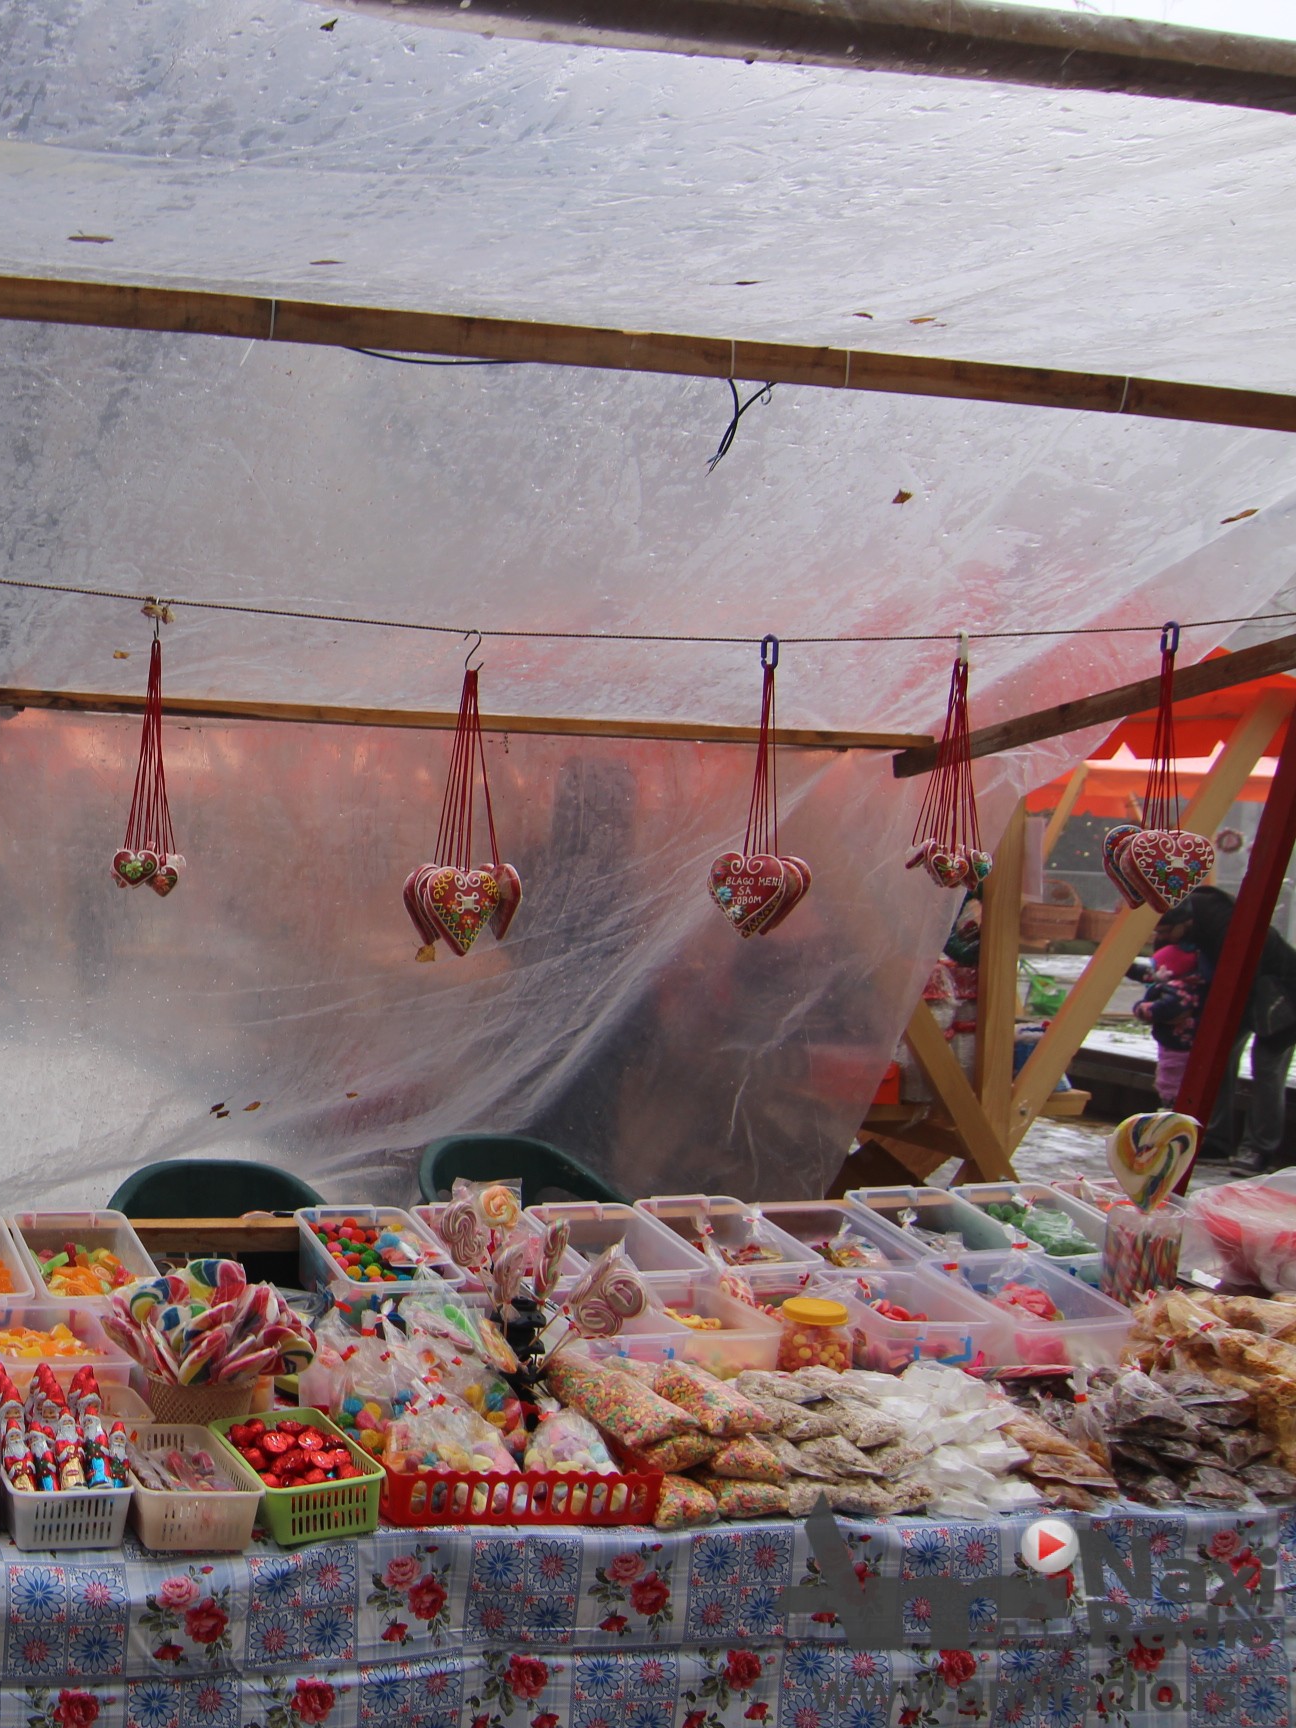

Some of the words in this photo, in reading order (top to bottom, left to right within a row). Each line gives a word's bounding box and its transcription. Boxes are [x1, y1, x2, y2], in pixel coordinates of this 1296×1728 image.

[725, 876, 754, 886] BLAGO
[737, 886, 752, 895] SA
[731, 895, 762, 905] TOBOM
